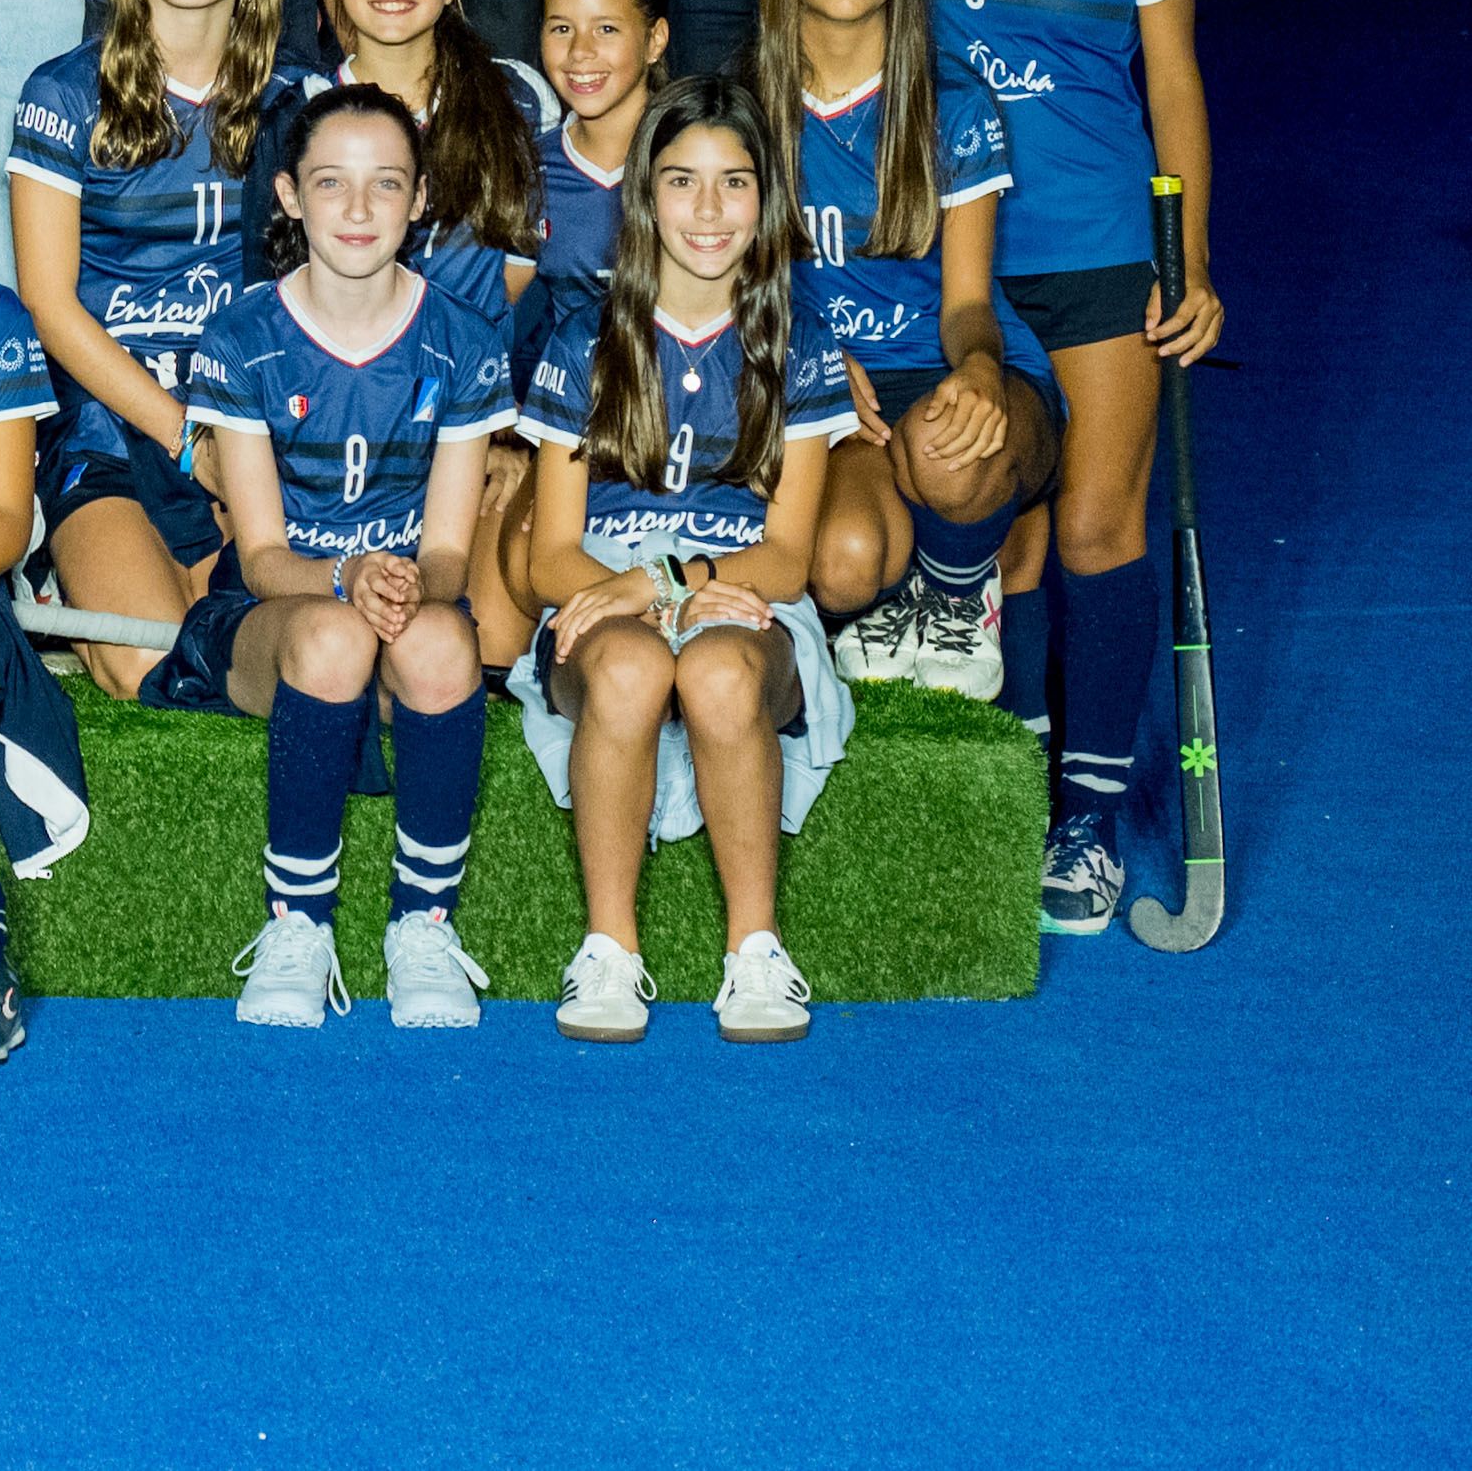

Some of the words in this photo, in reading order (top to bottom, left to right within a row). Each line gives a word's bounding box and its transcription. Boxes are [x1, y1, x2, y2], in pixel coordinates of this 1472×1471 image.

[988, 57, 1055, 95] Cuba
[192, 181, 223, 246] 11
[803, 205, 845, 269] 10
[104, 283, 207, 336] Enjoy
[343, 433, 368, 504] 8
[664, 423, 694, 493] 9
[285, 520, 363, 552] njoy
